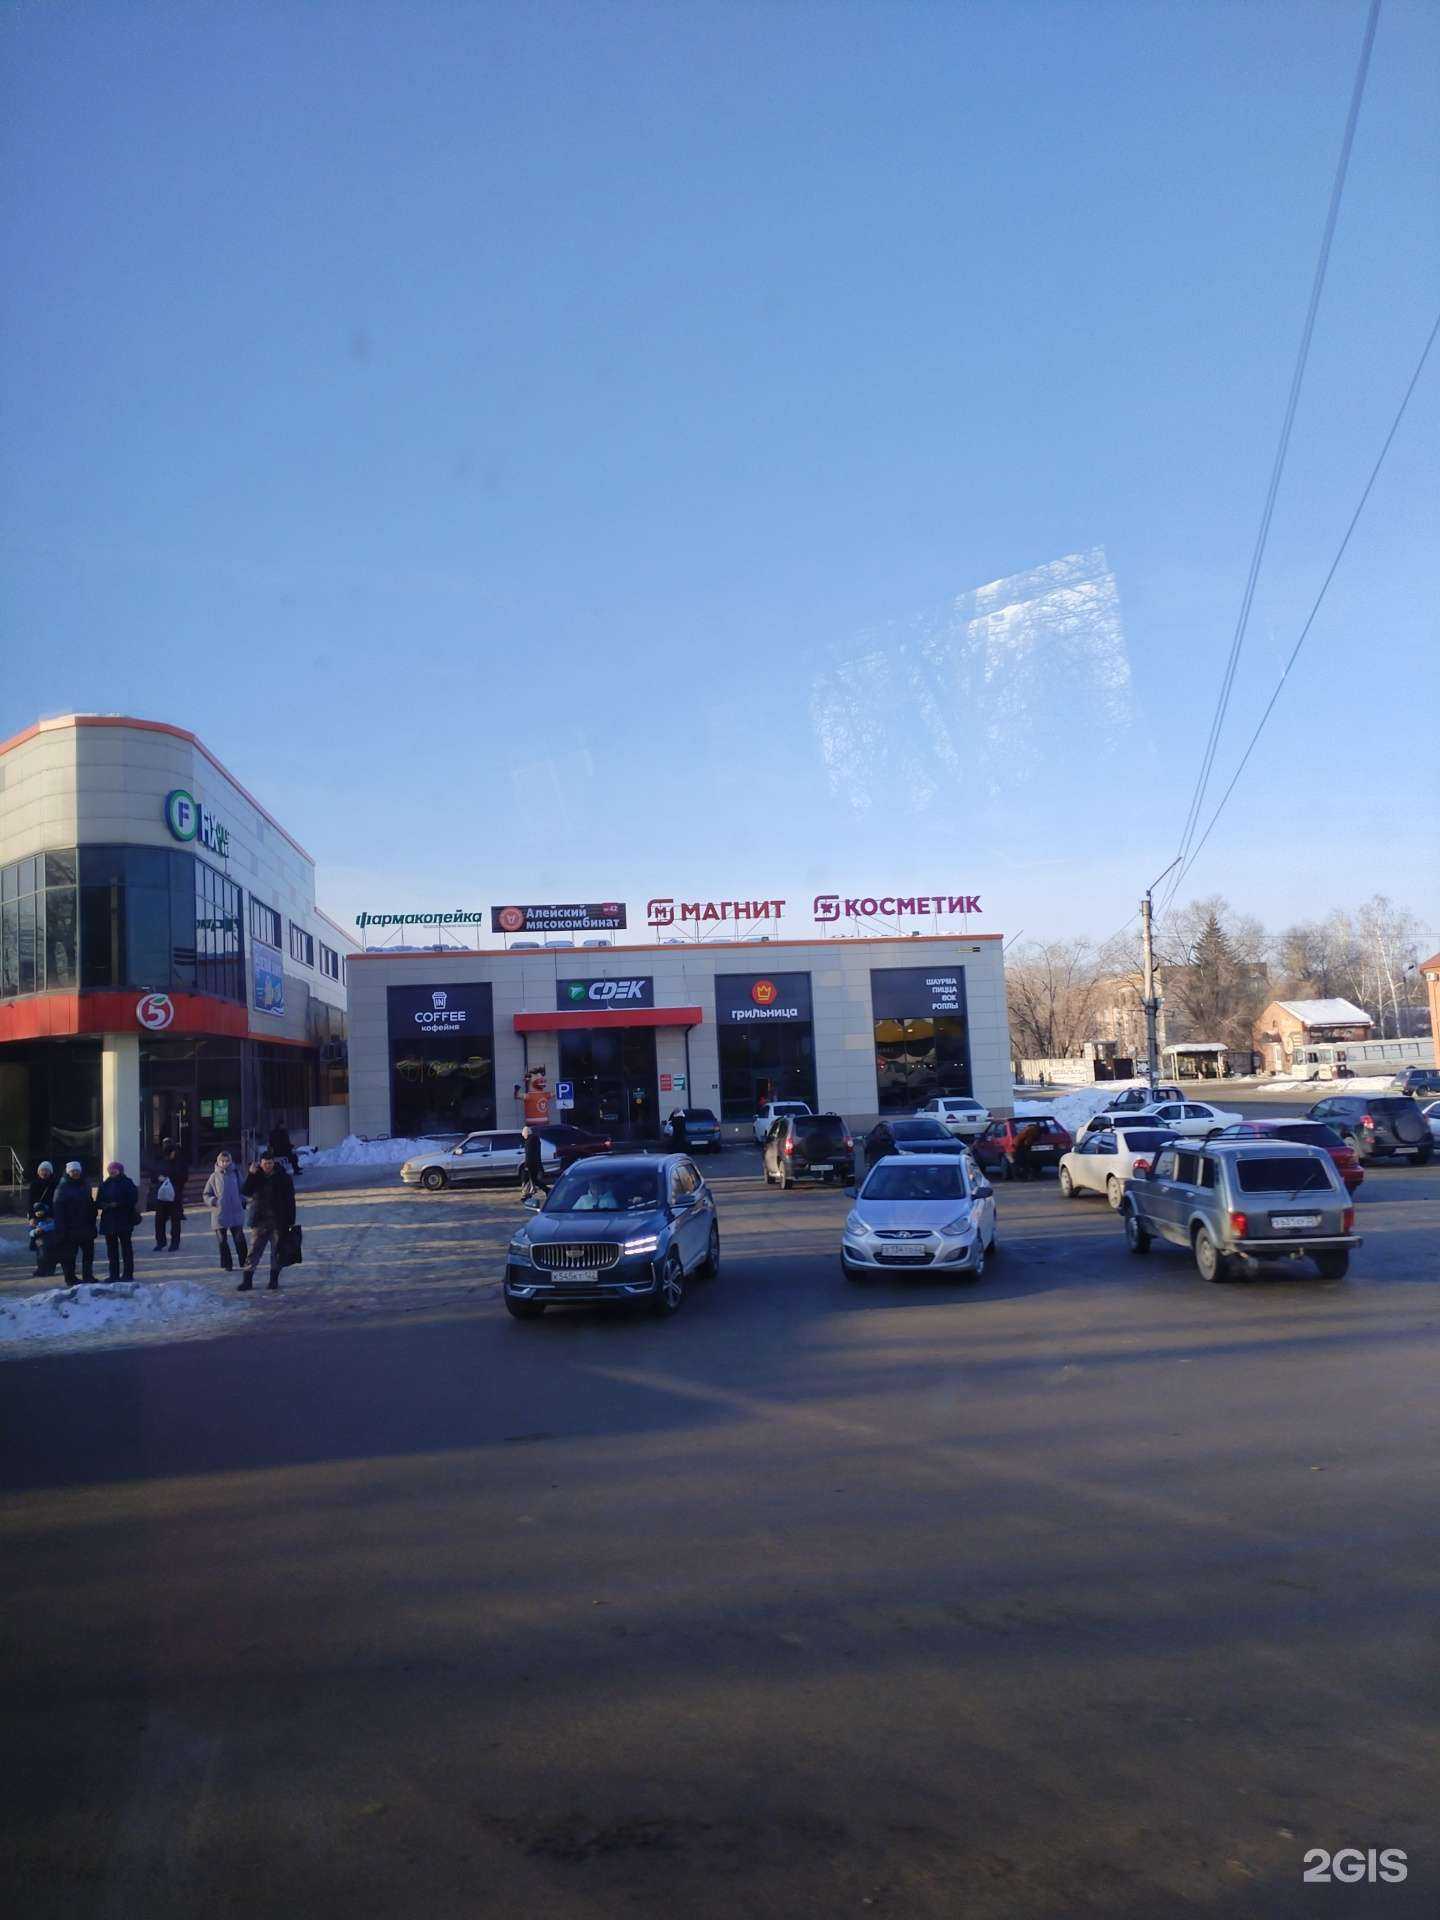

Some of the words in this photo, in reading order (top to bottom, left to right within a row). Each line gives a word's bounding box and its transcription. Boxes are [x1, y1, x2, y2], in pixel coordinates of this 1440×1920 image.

[526, 905, 587, 919] Алейский
[681, 900, 786, 921] МАГНИТ
[845, 895, 982, 917] КОСМЕТИК
[356, 909, 482, 929] фармакопейка
[526, 917, 620, 930] мясокомбинат
[926, 977, 957, 986] ШАУРМА
[588, 980, 646, 999] CDEK
[932, 986, 958, 994] ПИЦЦА
[414, 1011, 466, 1023] COFFEE
[731, 1007, 798, 1021] грильница
[421, 1023, 461, 1032] кофейня
